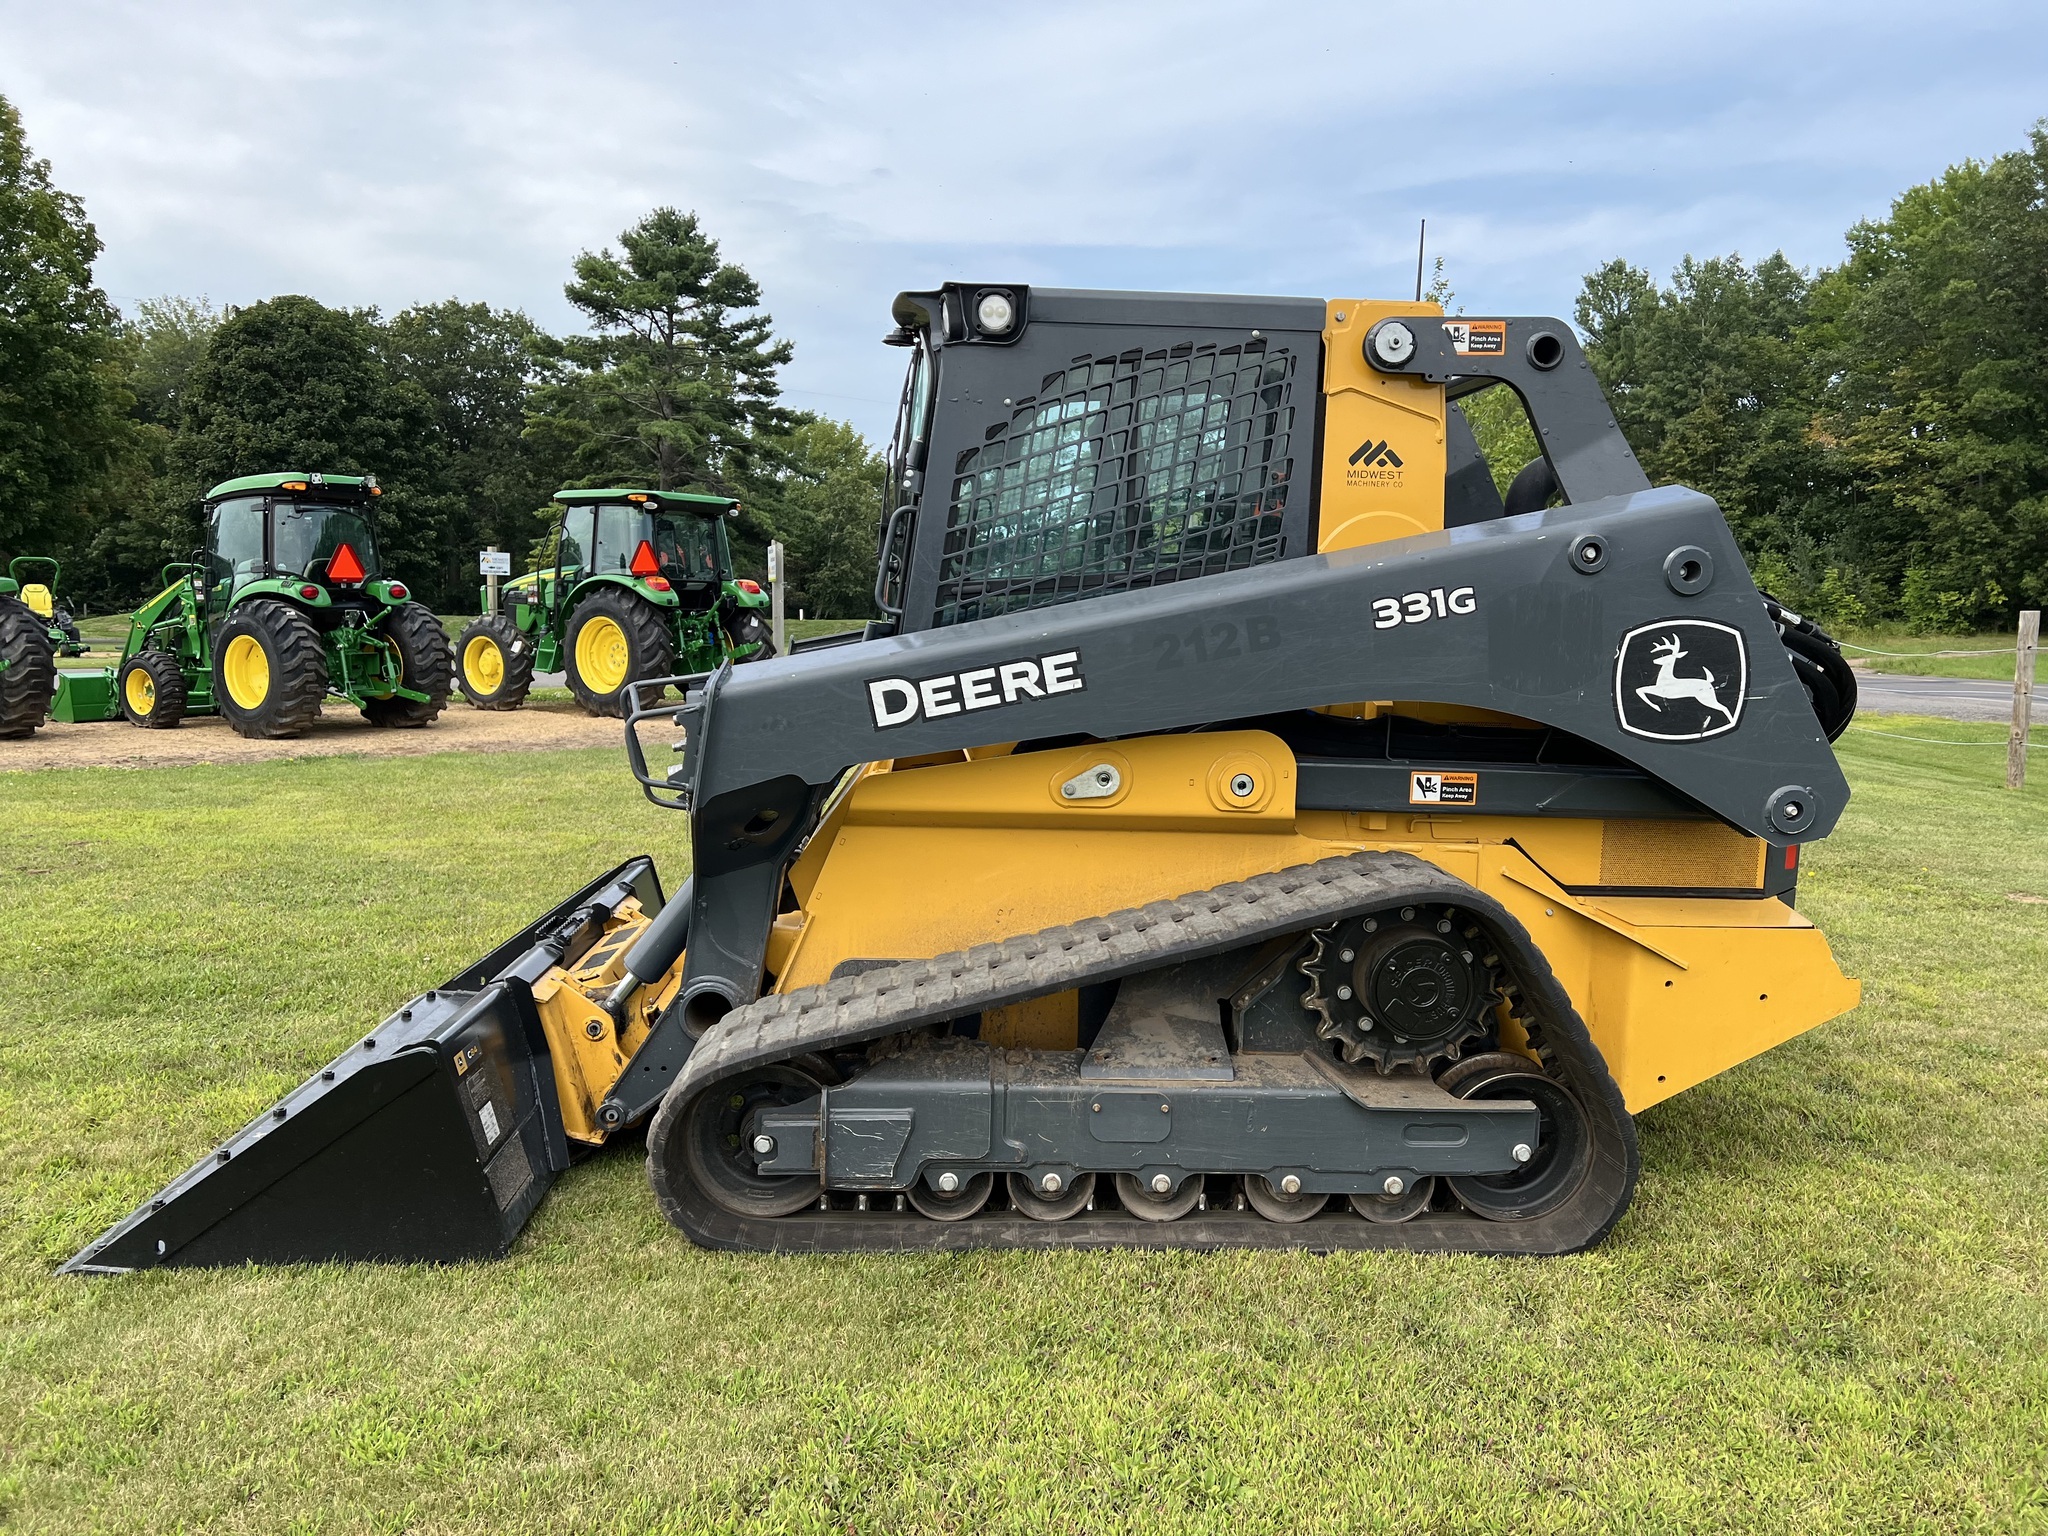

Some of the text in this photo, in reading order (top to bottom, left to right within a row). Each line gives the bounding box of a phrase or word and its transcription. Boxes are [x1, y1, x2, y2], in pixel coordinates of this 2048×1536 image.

[1346, 470, 1404, 480] MIDWEST
[1346, 480, 1390, 488] MACHINERY
[1372, 586, 1477, 629] 331G
[1152, 613, 1282, 671] 212B
[867, 650, 1084, 729] DEERE
